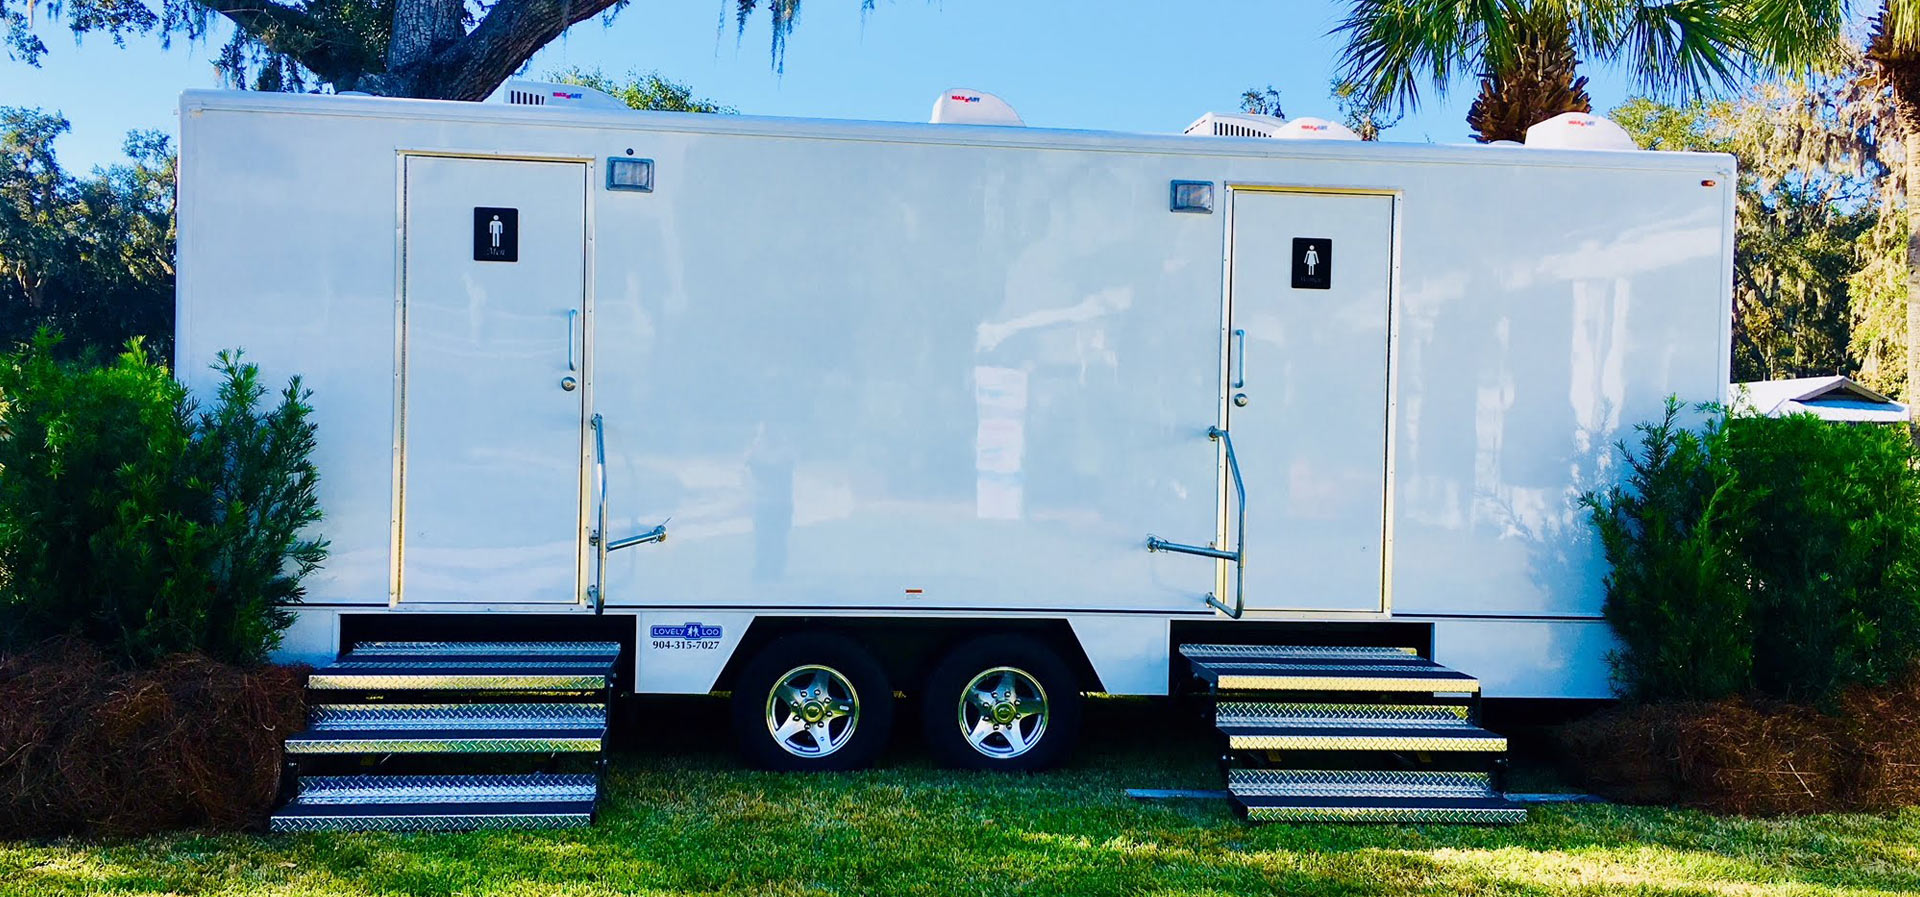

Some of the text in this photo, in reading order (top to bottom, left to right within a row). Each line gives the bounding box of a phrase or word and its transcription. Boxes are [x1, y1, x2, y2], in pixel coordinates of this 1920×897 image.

[653, 628, 720, 636] LOVELY LOO
[652, 640, 720, 650] 904-315-7027
